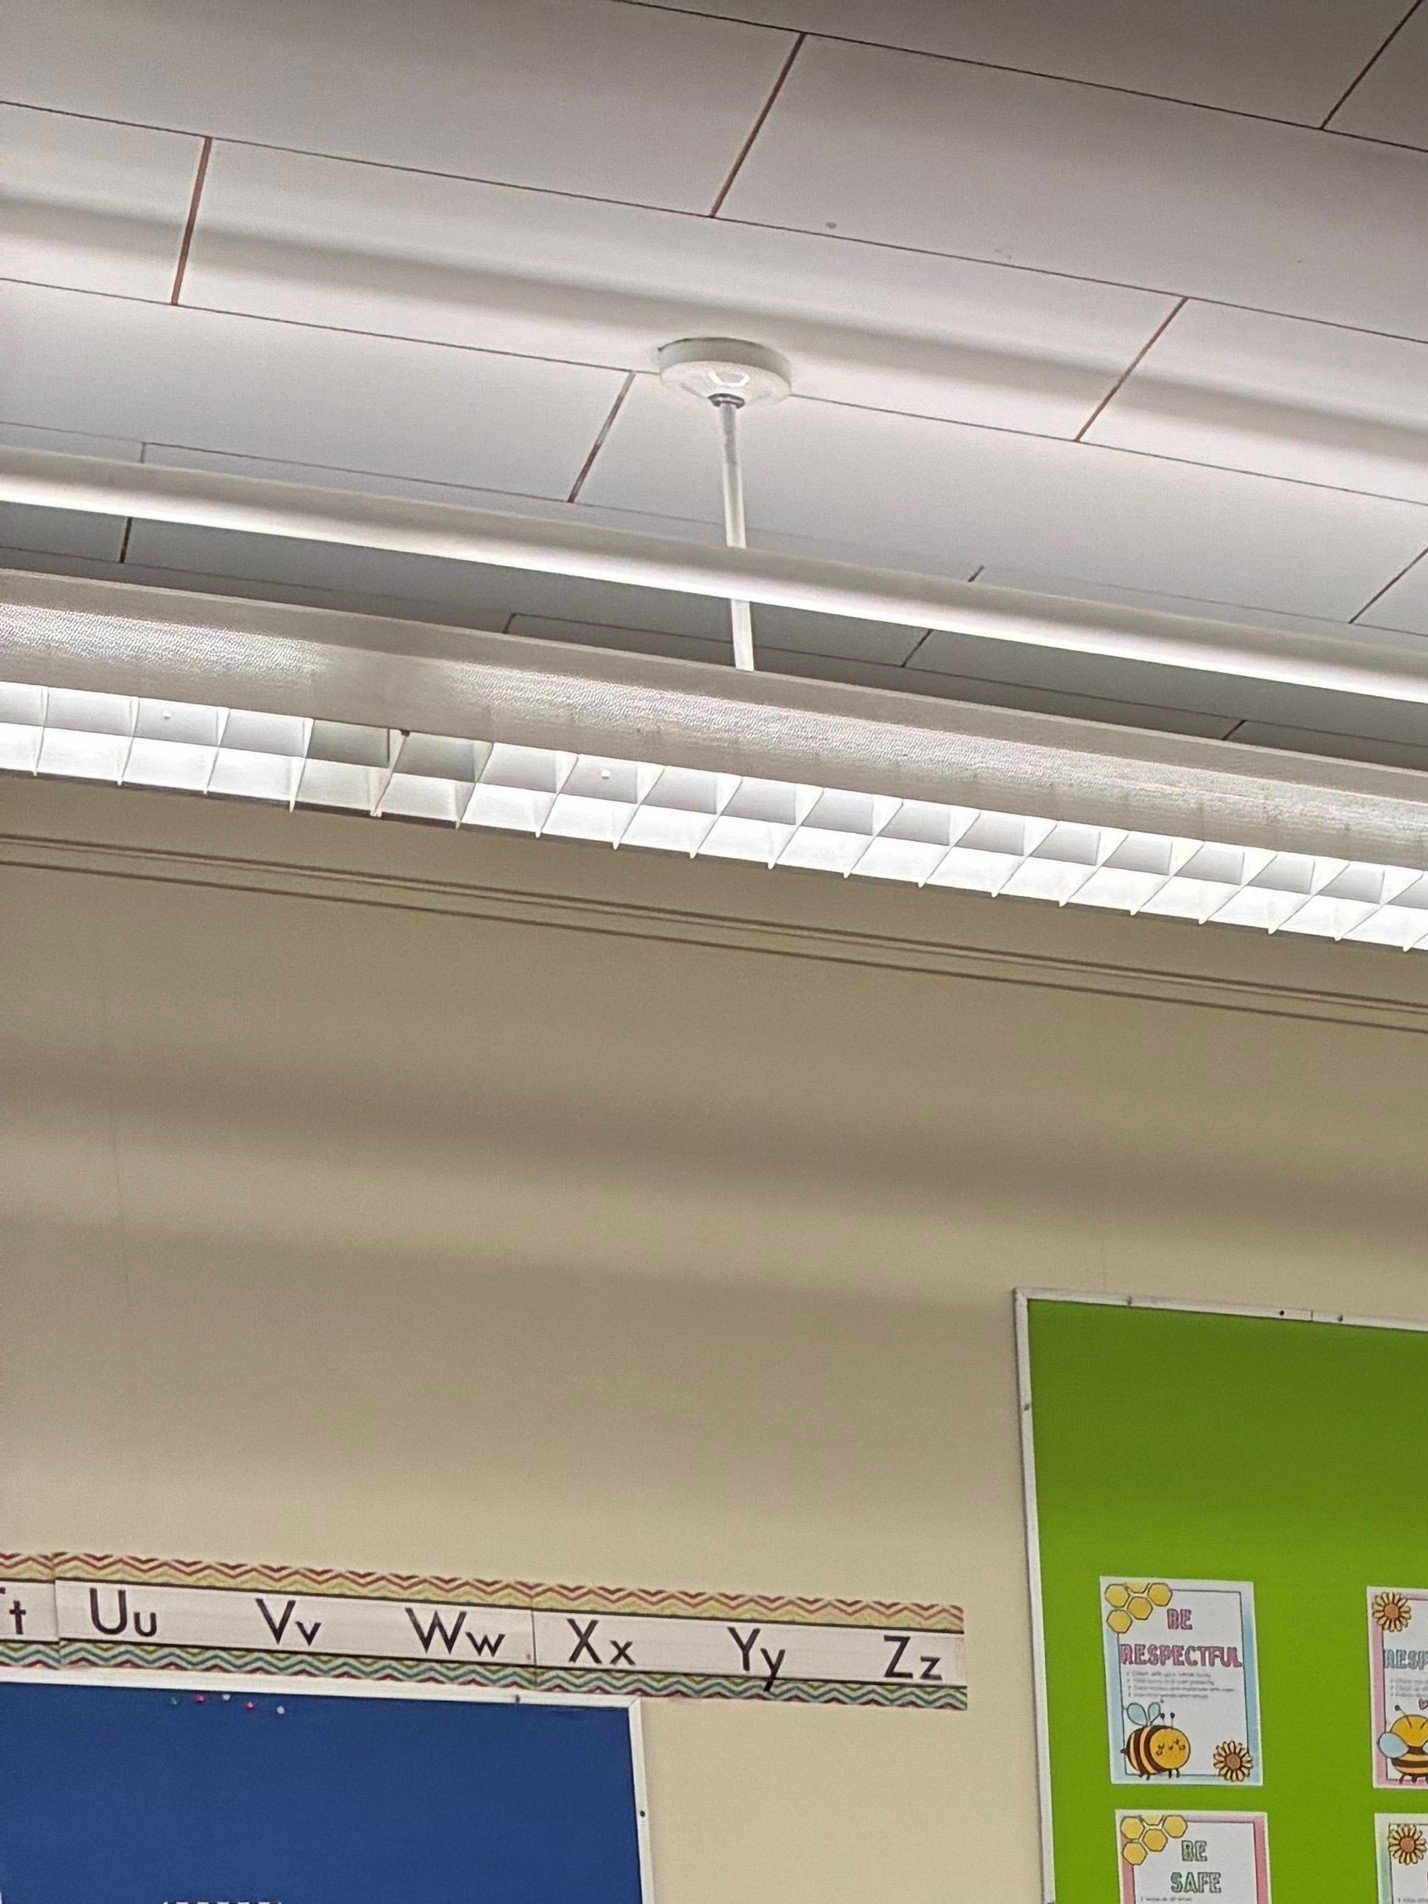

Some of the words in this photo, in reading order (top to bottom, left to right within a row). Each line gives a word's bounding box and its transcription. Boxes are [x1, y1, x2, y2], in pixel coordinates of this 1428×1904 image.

[1166, 1608, 1193, 1631] BE
[89, 1587, 158, 1638] Uu
[255, 1598, 322, 1647] Vv
[405, 1606, 506, 1657] Ww
[566, 1618, 637, 1667] Xx
[727, 1626, 787, 1692] Yy
[882, 1634, 944, 1681] Zz
[1119, 1643, 1243, 1668] RESPECTFUL
[1181, 1840, 1208, 1862] BE
[1170, 1871, 1222, 1894] SAFE
